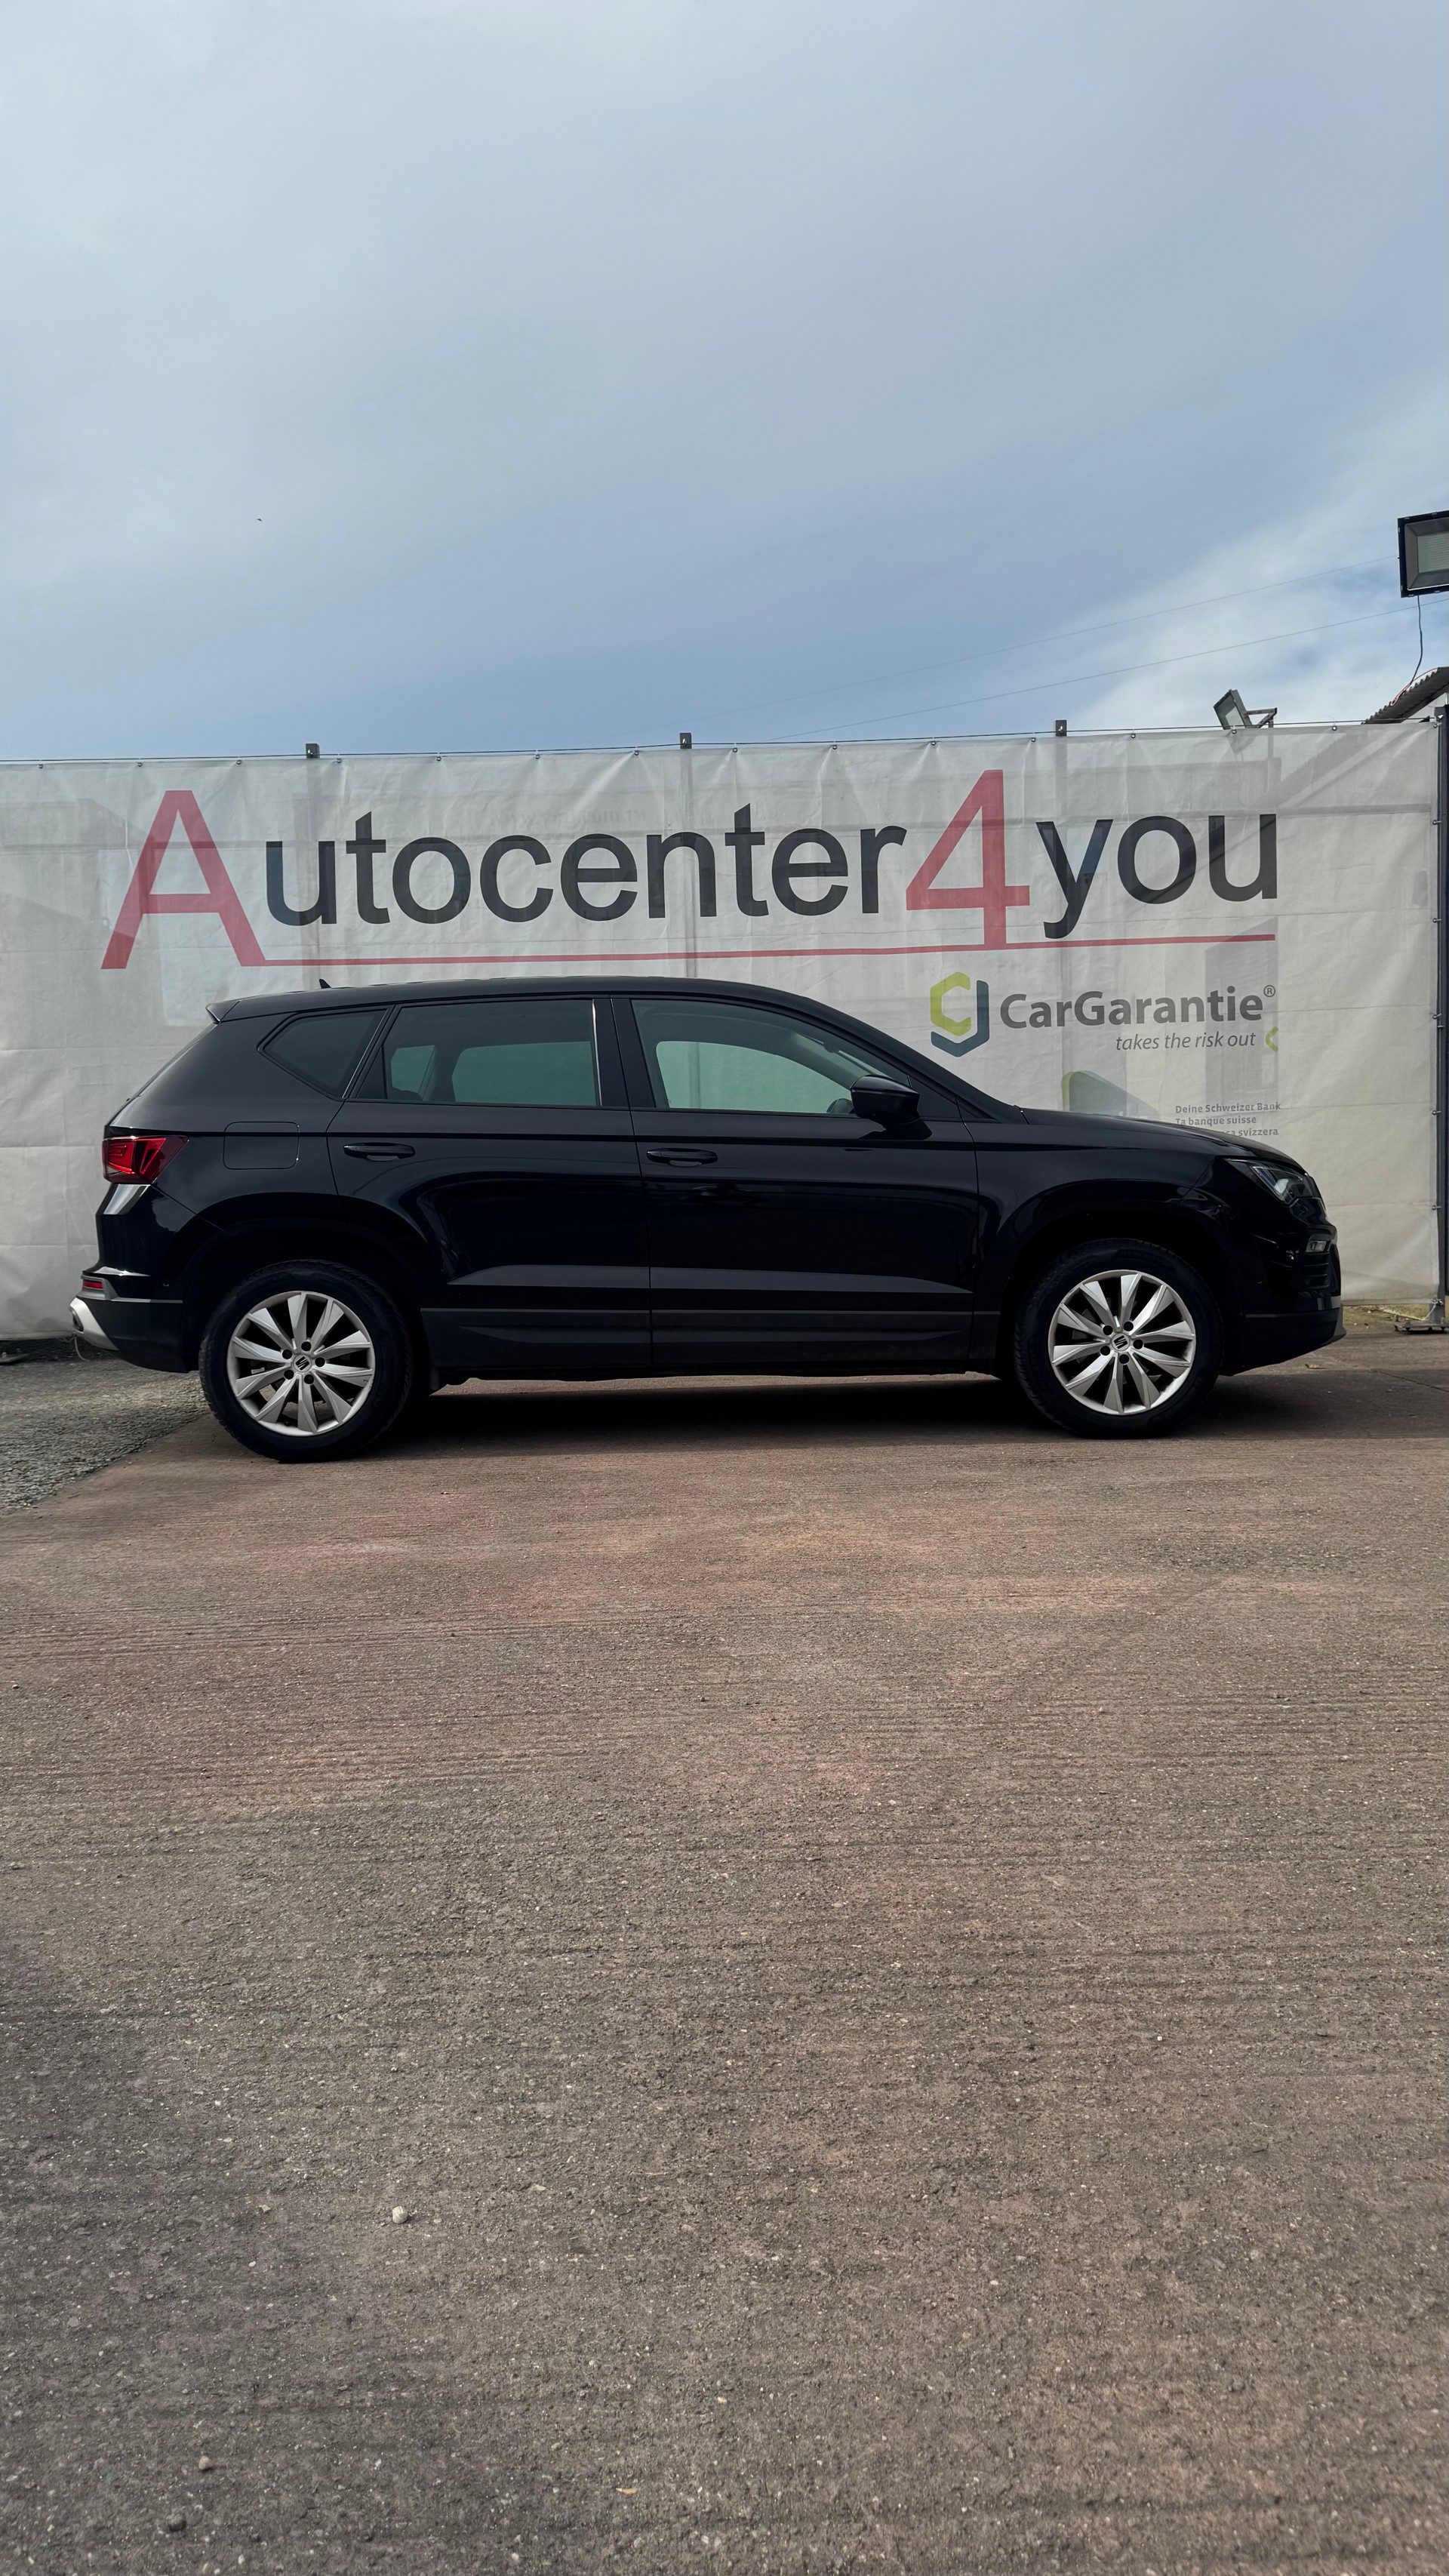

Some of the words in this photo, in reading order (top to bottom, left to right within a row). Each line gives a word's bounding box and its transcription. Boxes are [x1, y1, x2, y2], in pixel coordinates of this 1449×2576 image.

[101, 769, 1278, 969] Autocenter4you
[1116, 1033, 1159, 1050] takes
[1164, 1033, 1191, 1048] the
[1195, 1031, 1223, 1048] risk
[1227, 1033, 1256, 1047] out
[1175, 1105, 1203, 1113] Deine
[1205, 1103, 1255, 1113] Schweizer
[1257, 1101, 1281, 1110] Bank
[1189, 1117, 1225, 1126] banque
[1226, 1116, 1257, 1124] suisse
[1238, 1128, 1278, 1137] svizzera
